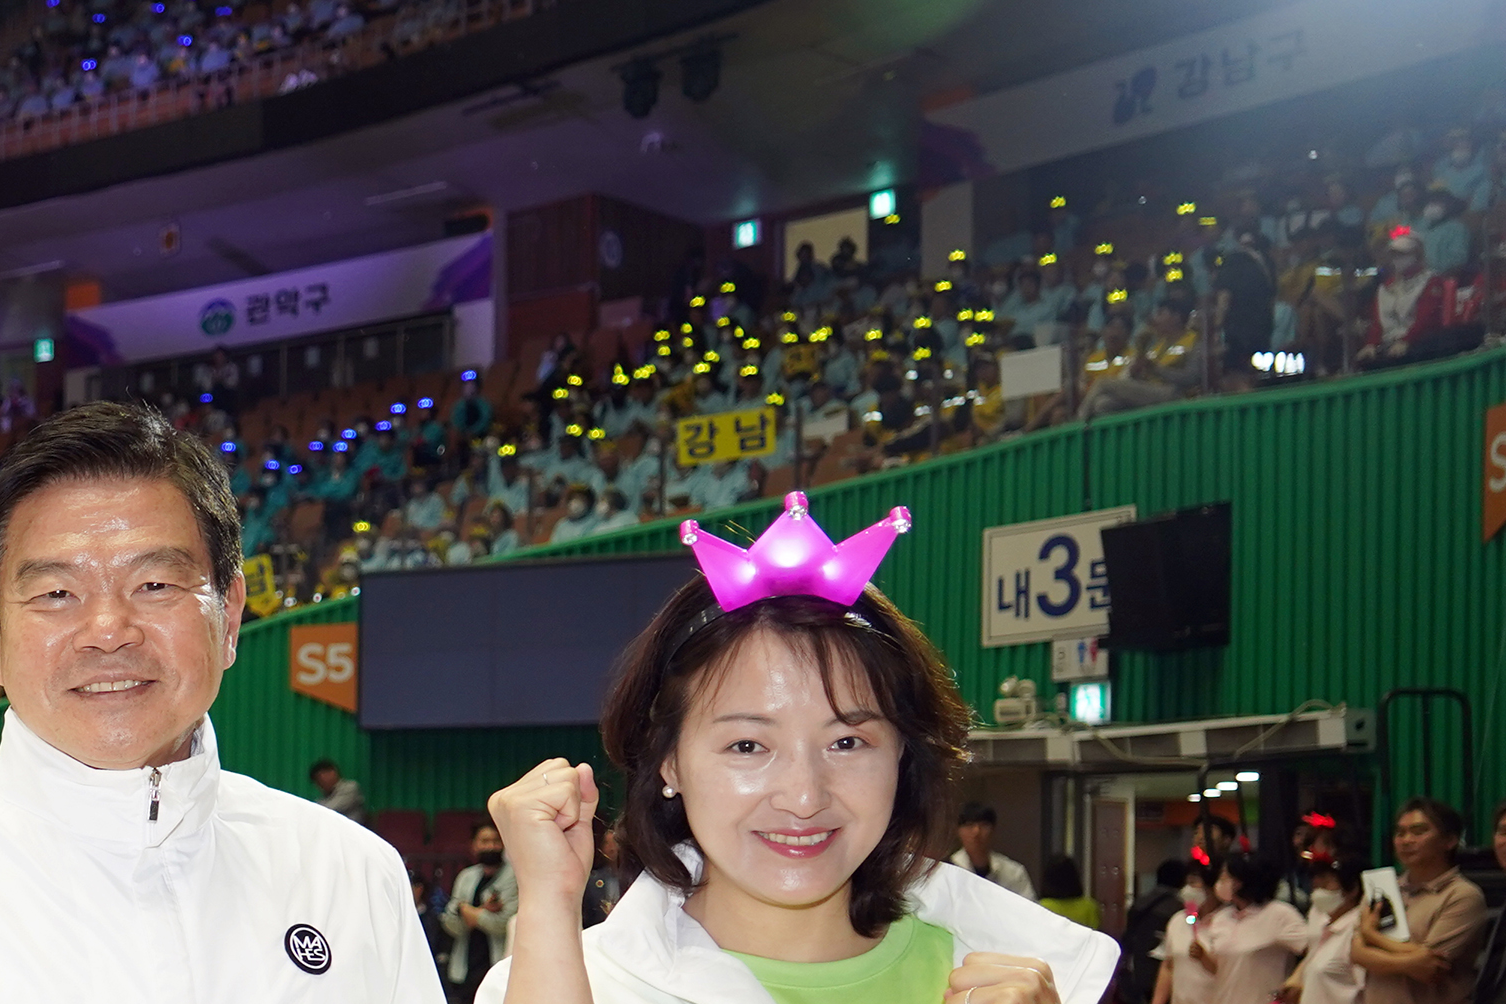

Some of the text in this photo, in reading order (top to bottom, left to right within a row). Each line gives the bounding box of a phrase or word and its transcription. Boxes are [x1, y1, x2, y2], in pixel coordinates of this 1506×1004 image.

[1175, 27, 1303, 98] 강남구
[246, 283, 330, 325] 관악구
[296, 642, 355, 686] S5
